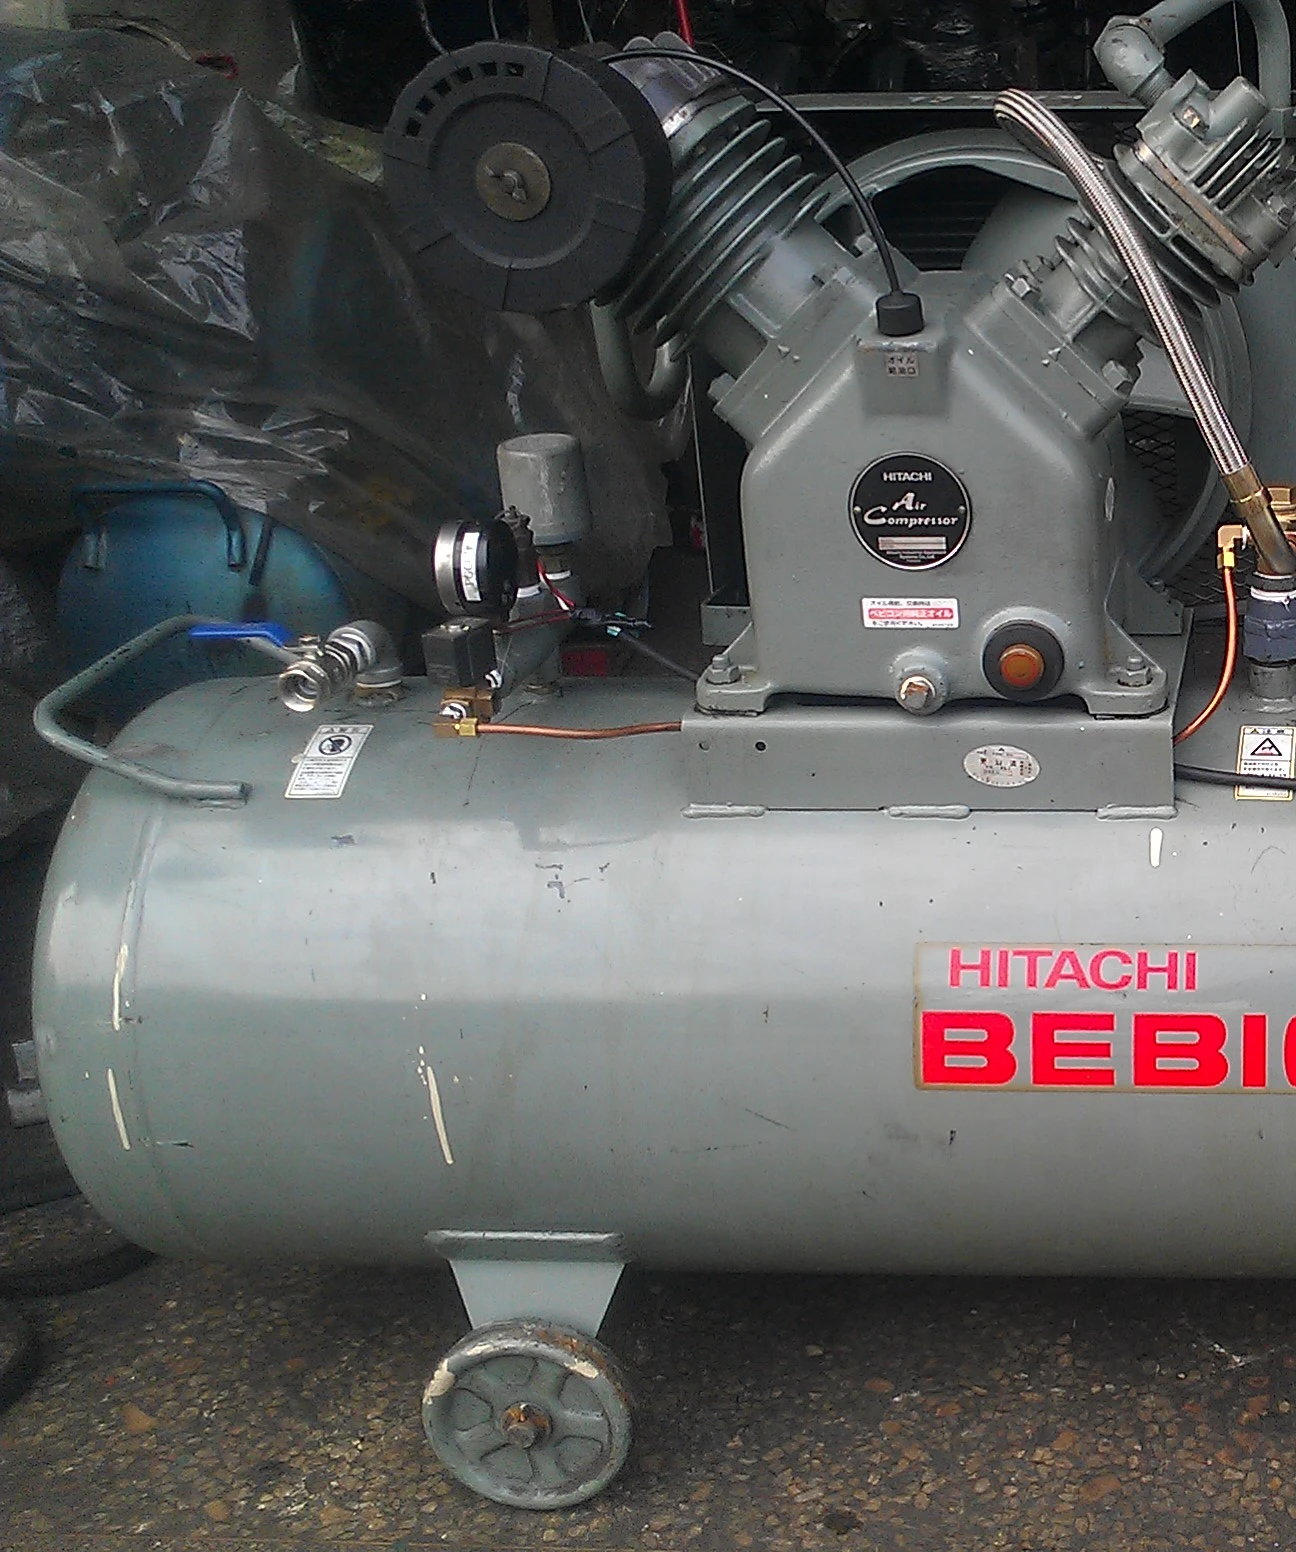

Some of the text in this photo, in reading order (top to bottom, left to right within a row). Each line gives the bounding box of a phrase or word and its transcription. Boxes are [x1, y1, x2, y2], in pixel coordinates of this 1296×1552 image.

[883, 472, 932, 481] HITACHI
[892, 492, 927, 510] Air
[864, 505, 959, 528] Compressor
[949, 947, 1199, 992] HITACHI
